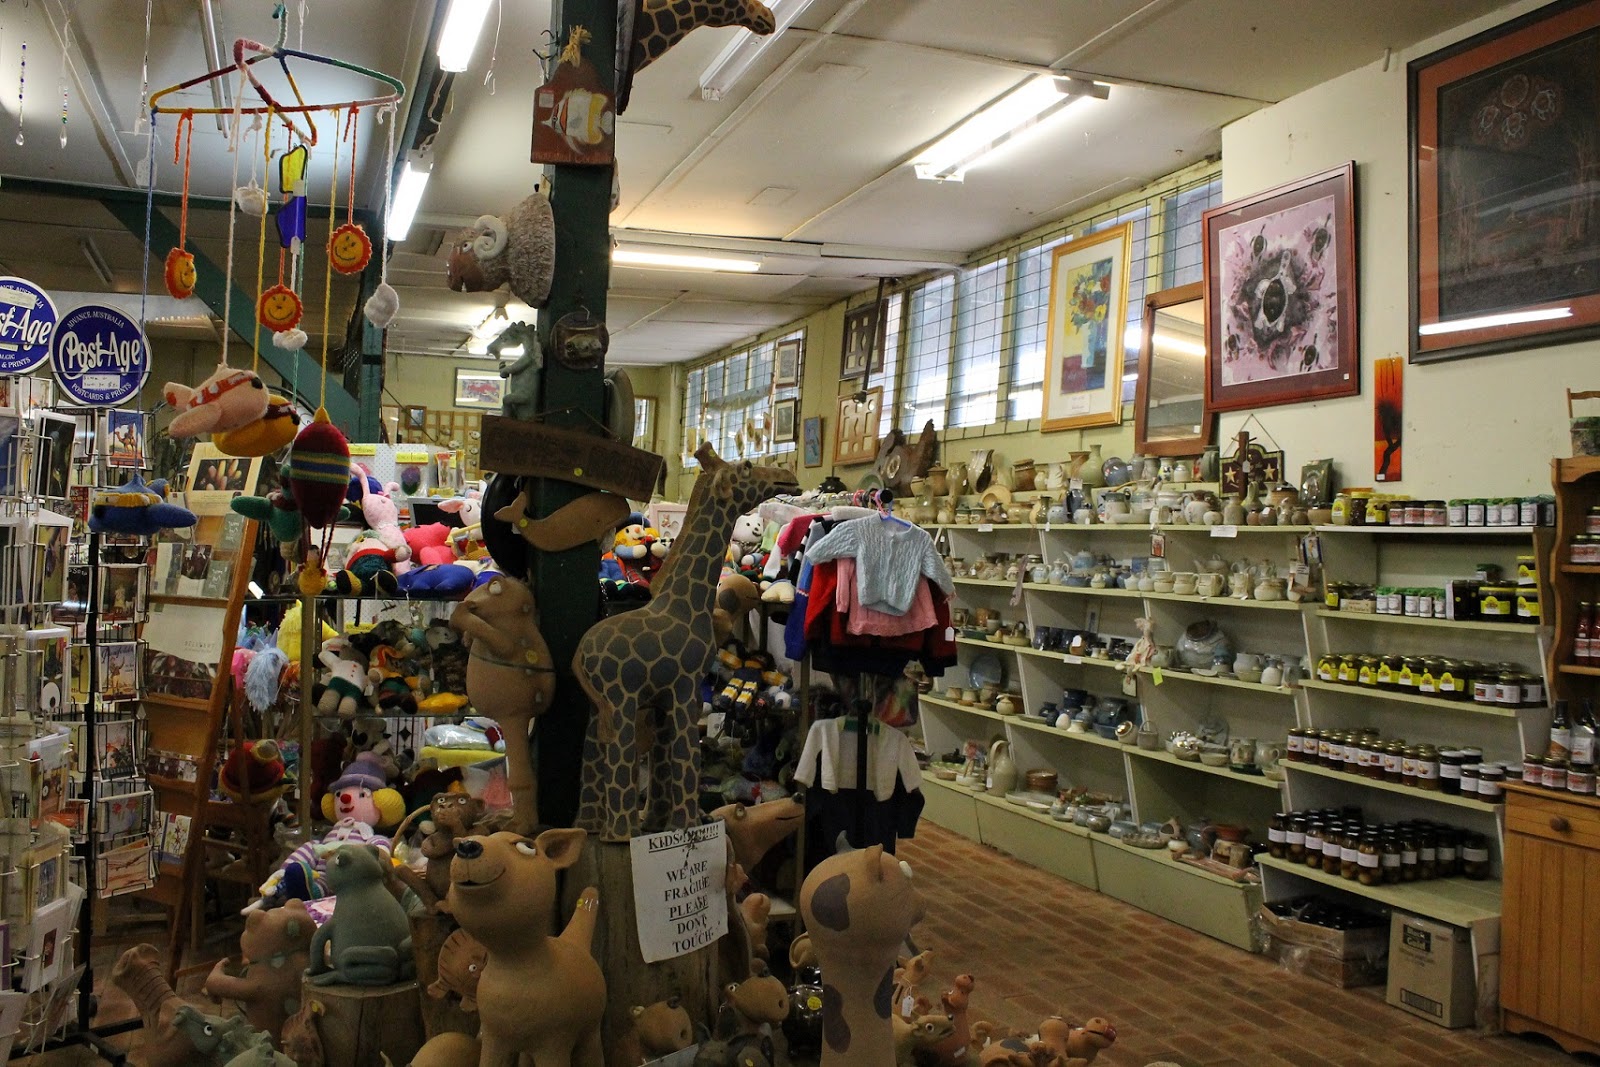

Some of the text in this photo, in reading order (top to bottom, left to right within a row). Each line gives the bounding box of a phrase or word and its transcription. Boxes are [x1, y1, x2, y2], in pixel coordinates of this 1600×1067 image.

[11, 308, 53, 351] Age
[67, 311, 125, 329] ADVANCE AUSTRALIA
[8, 357, 31, 368] PRINTS
[59, 331, 141, 380] Post Age
[71, 383, 104, 401] POSTCARDS
[111, 382, 132, 399] PRINTS
[666, 860, 708, 883] WE ARE
[664, 876, 710, 902] FRAGILE
[668, 895, 709, 919] PLEASE
